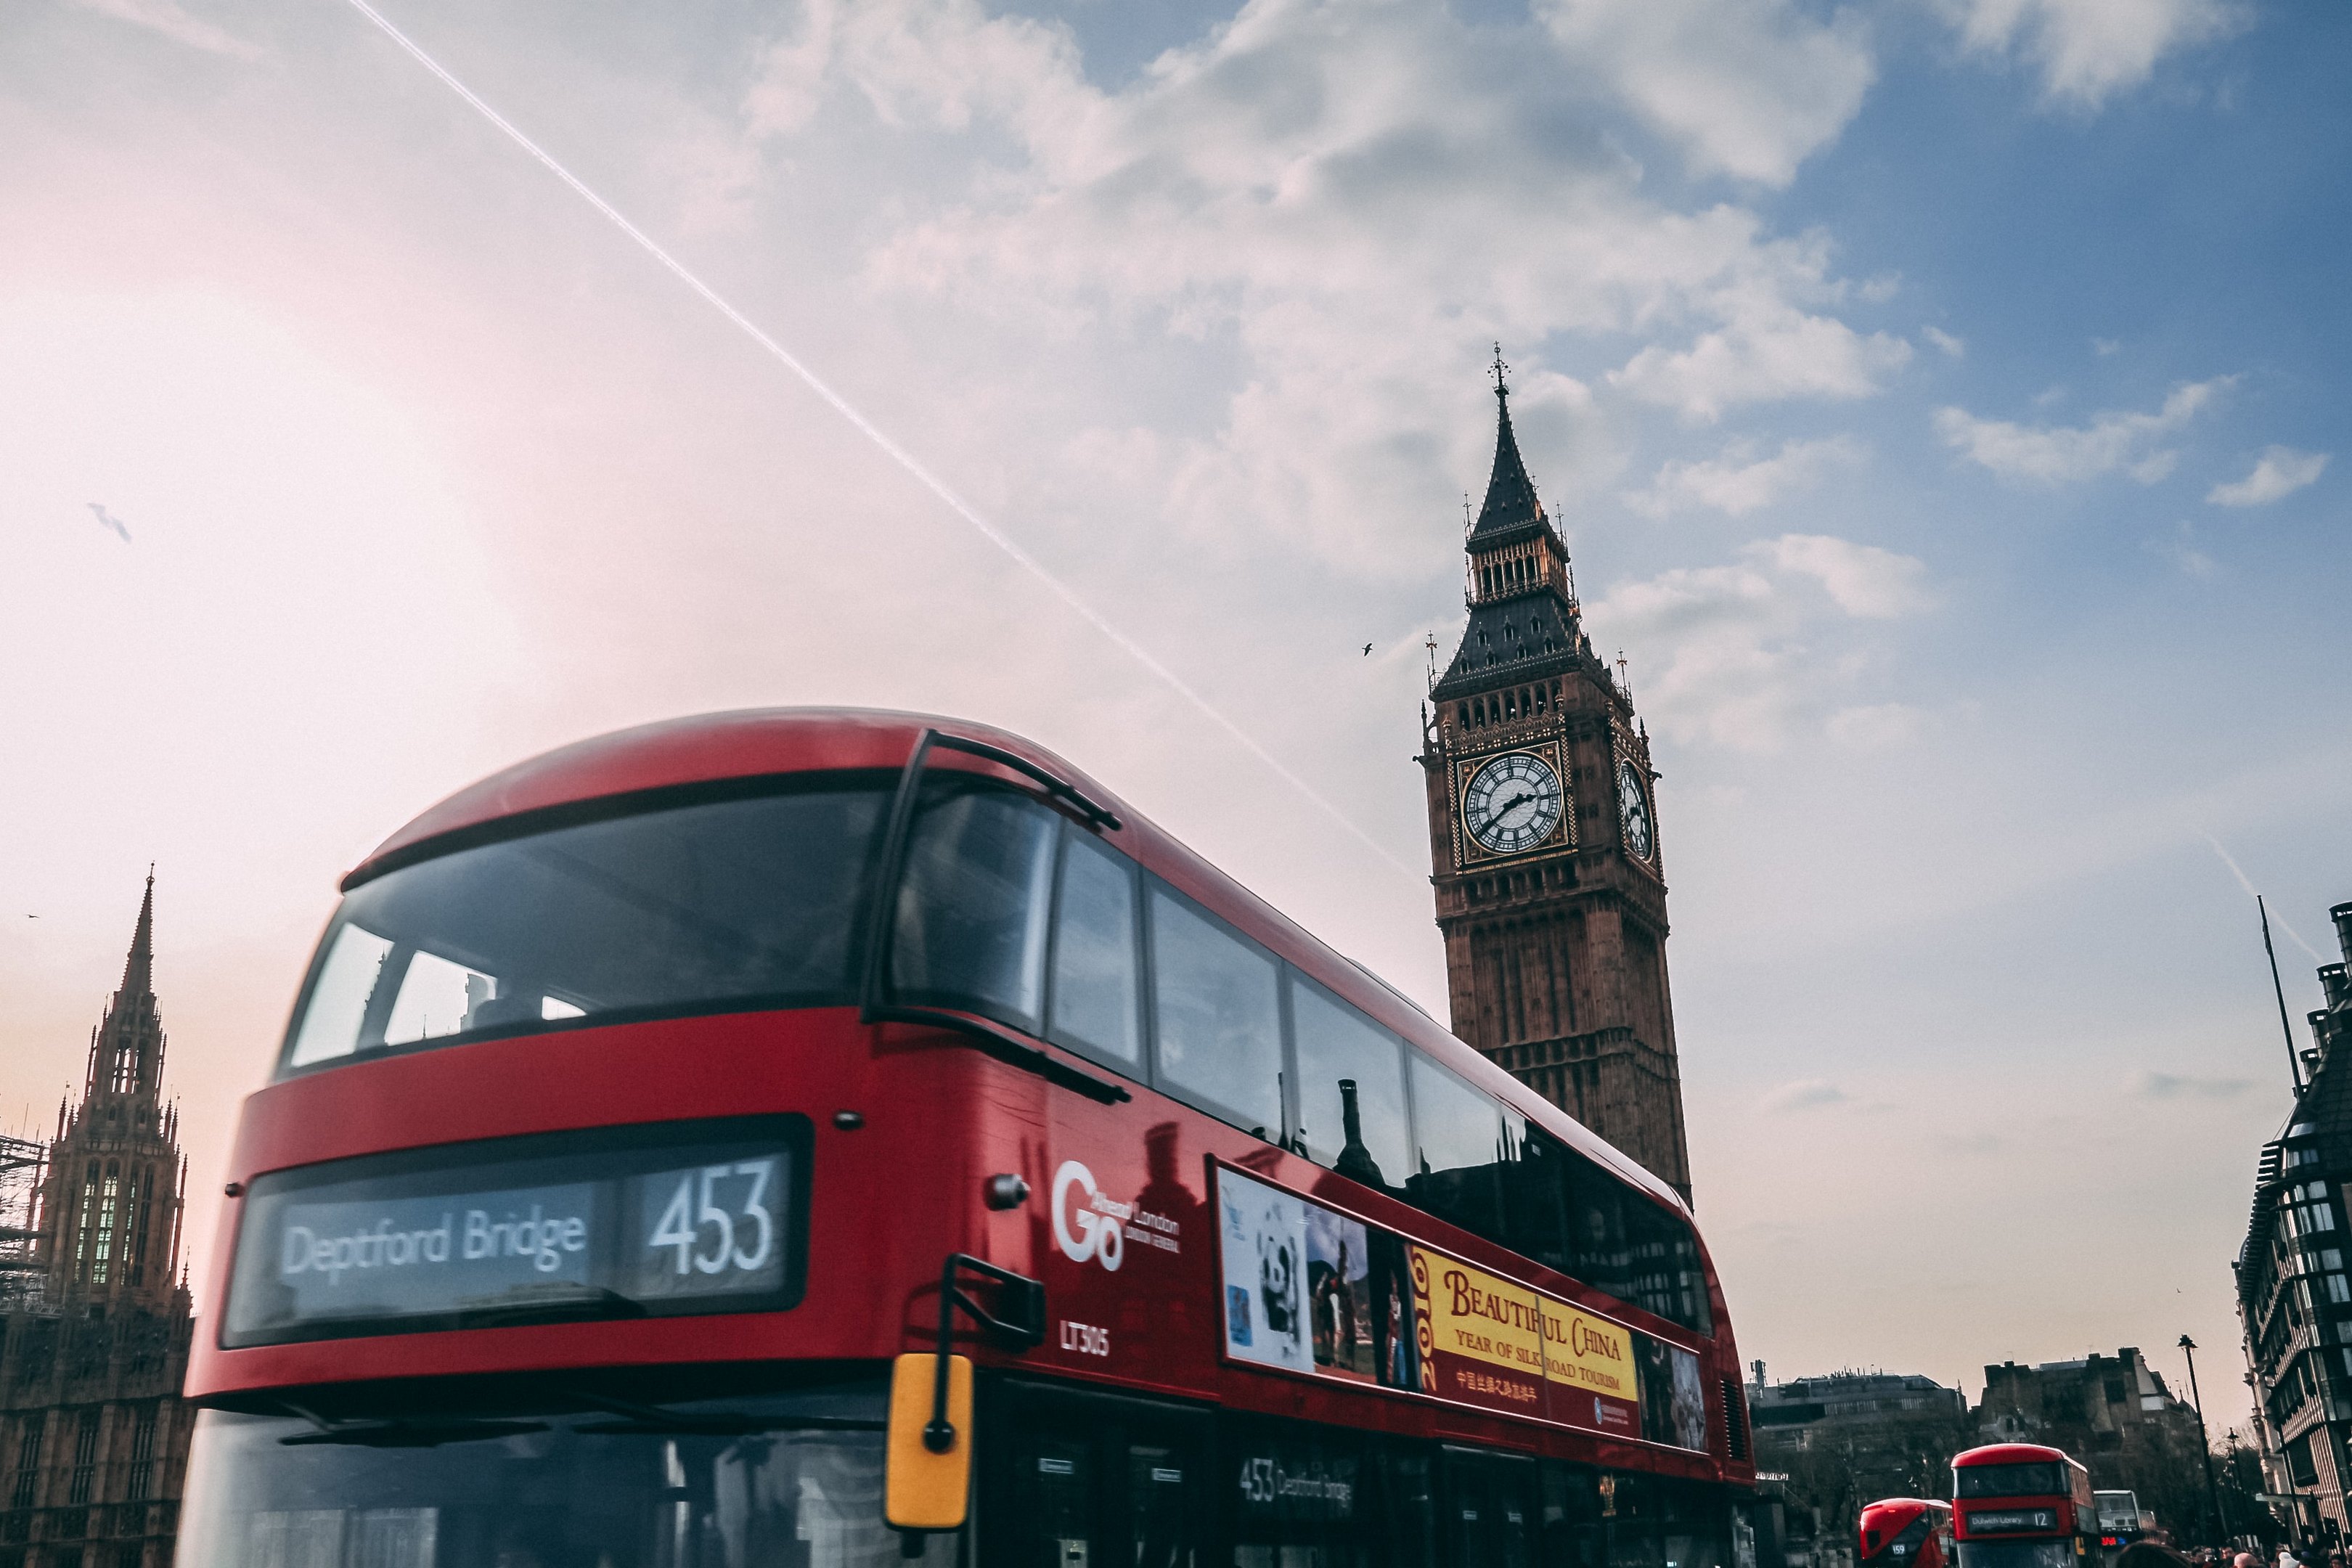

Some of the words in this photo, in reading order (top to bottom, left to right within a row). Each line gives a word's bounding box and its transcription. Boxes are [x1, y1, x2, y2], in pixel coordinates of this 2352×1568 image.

[284, 1212, 453, 1288] Deptford
[463, 1204, 586, 1272] Bridge
[650, 1161, 773, 1275] 453
[1051, 1160, 1124, 1271] Go
[1443, 1270, 1567, 1344] BEAUTIFUL
[1572, 1317, 1622, 1361] CHINA
[1455, 1328, 1493, 1354] YEAR
[1496, 1342, 1513, 1359] OF
[1515, 1347, 1543, 1367] SILK
[1545, 1356, 1576, 1379] ROAD
[1578, 1366, 1620, 1390] TOURISM
[1240, 1458, 1275, 1501] 453
[1892, 1544, 1906, 1555] 159
[2034, 1513, 2048, 1527] 12
